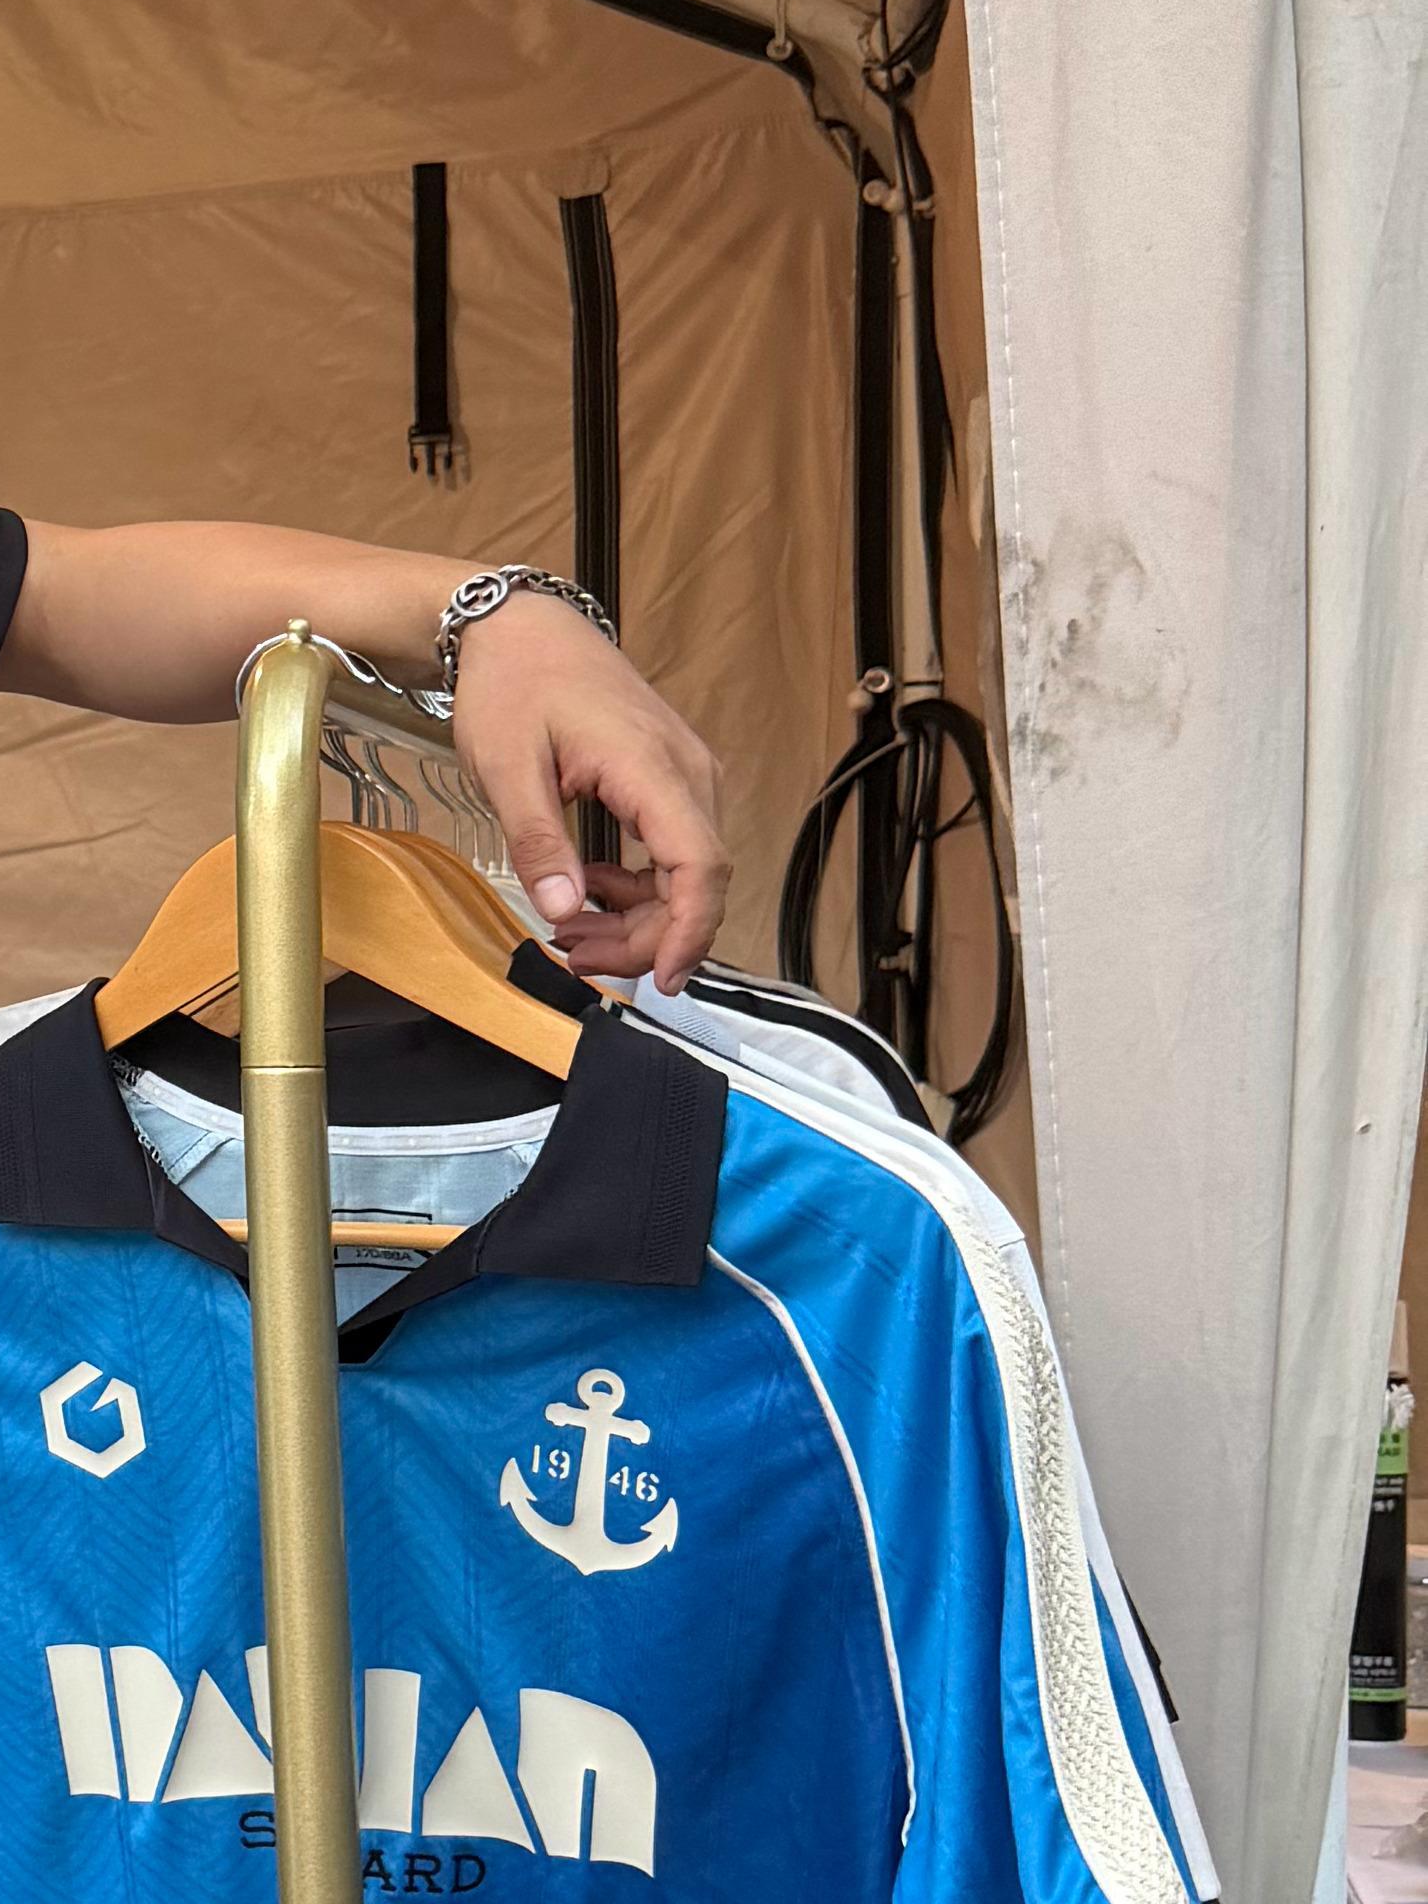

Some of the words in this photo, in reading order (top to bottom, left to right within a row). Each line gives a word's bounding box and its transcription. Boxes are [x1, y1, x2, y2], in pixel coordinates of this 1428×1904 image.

[531, 1443, 571, 1480] 19
[608, 1465, 660, 1502] 46
[238, 1809, 487, 1894] SARD
